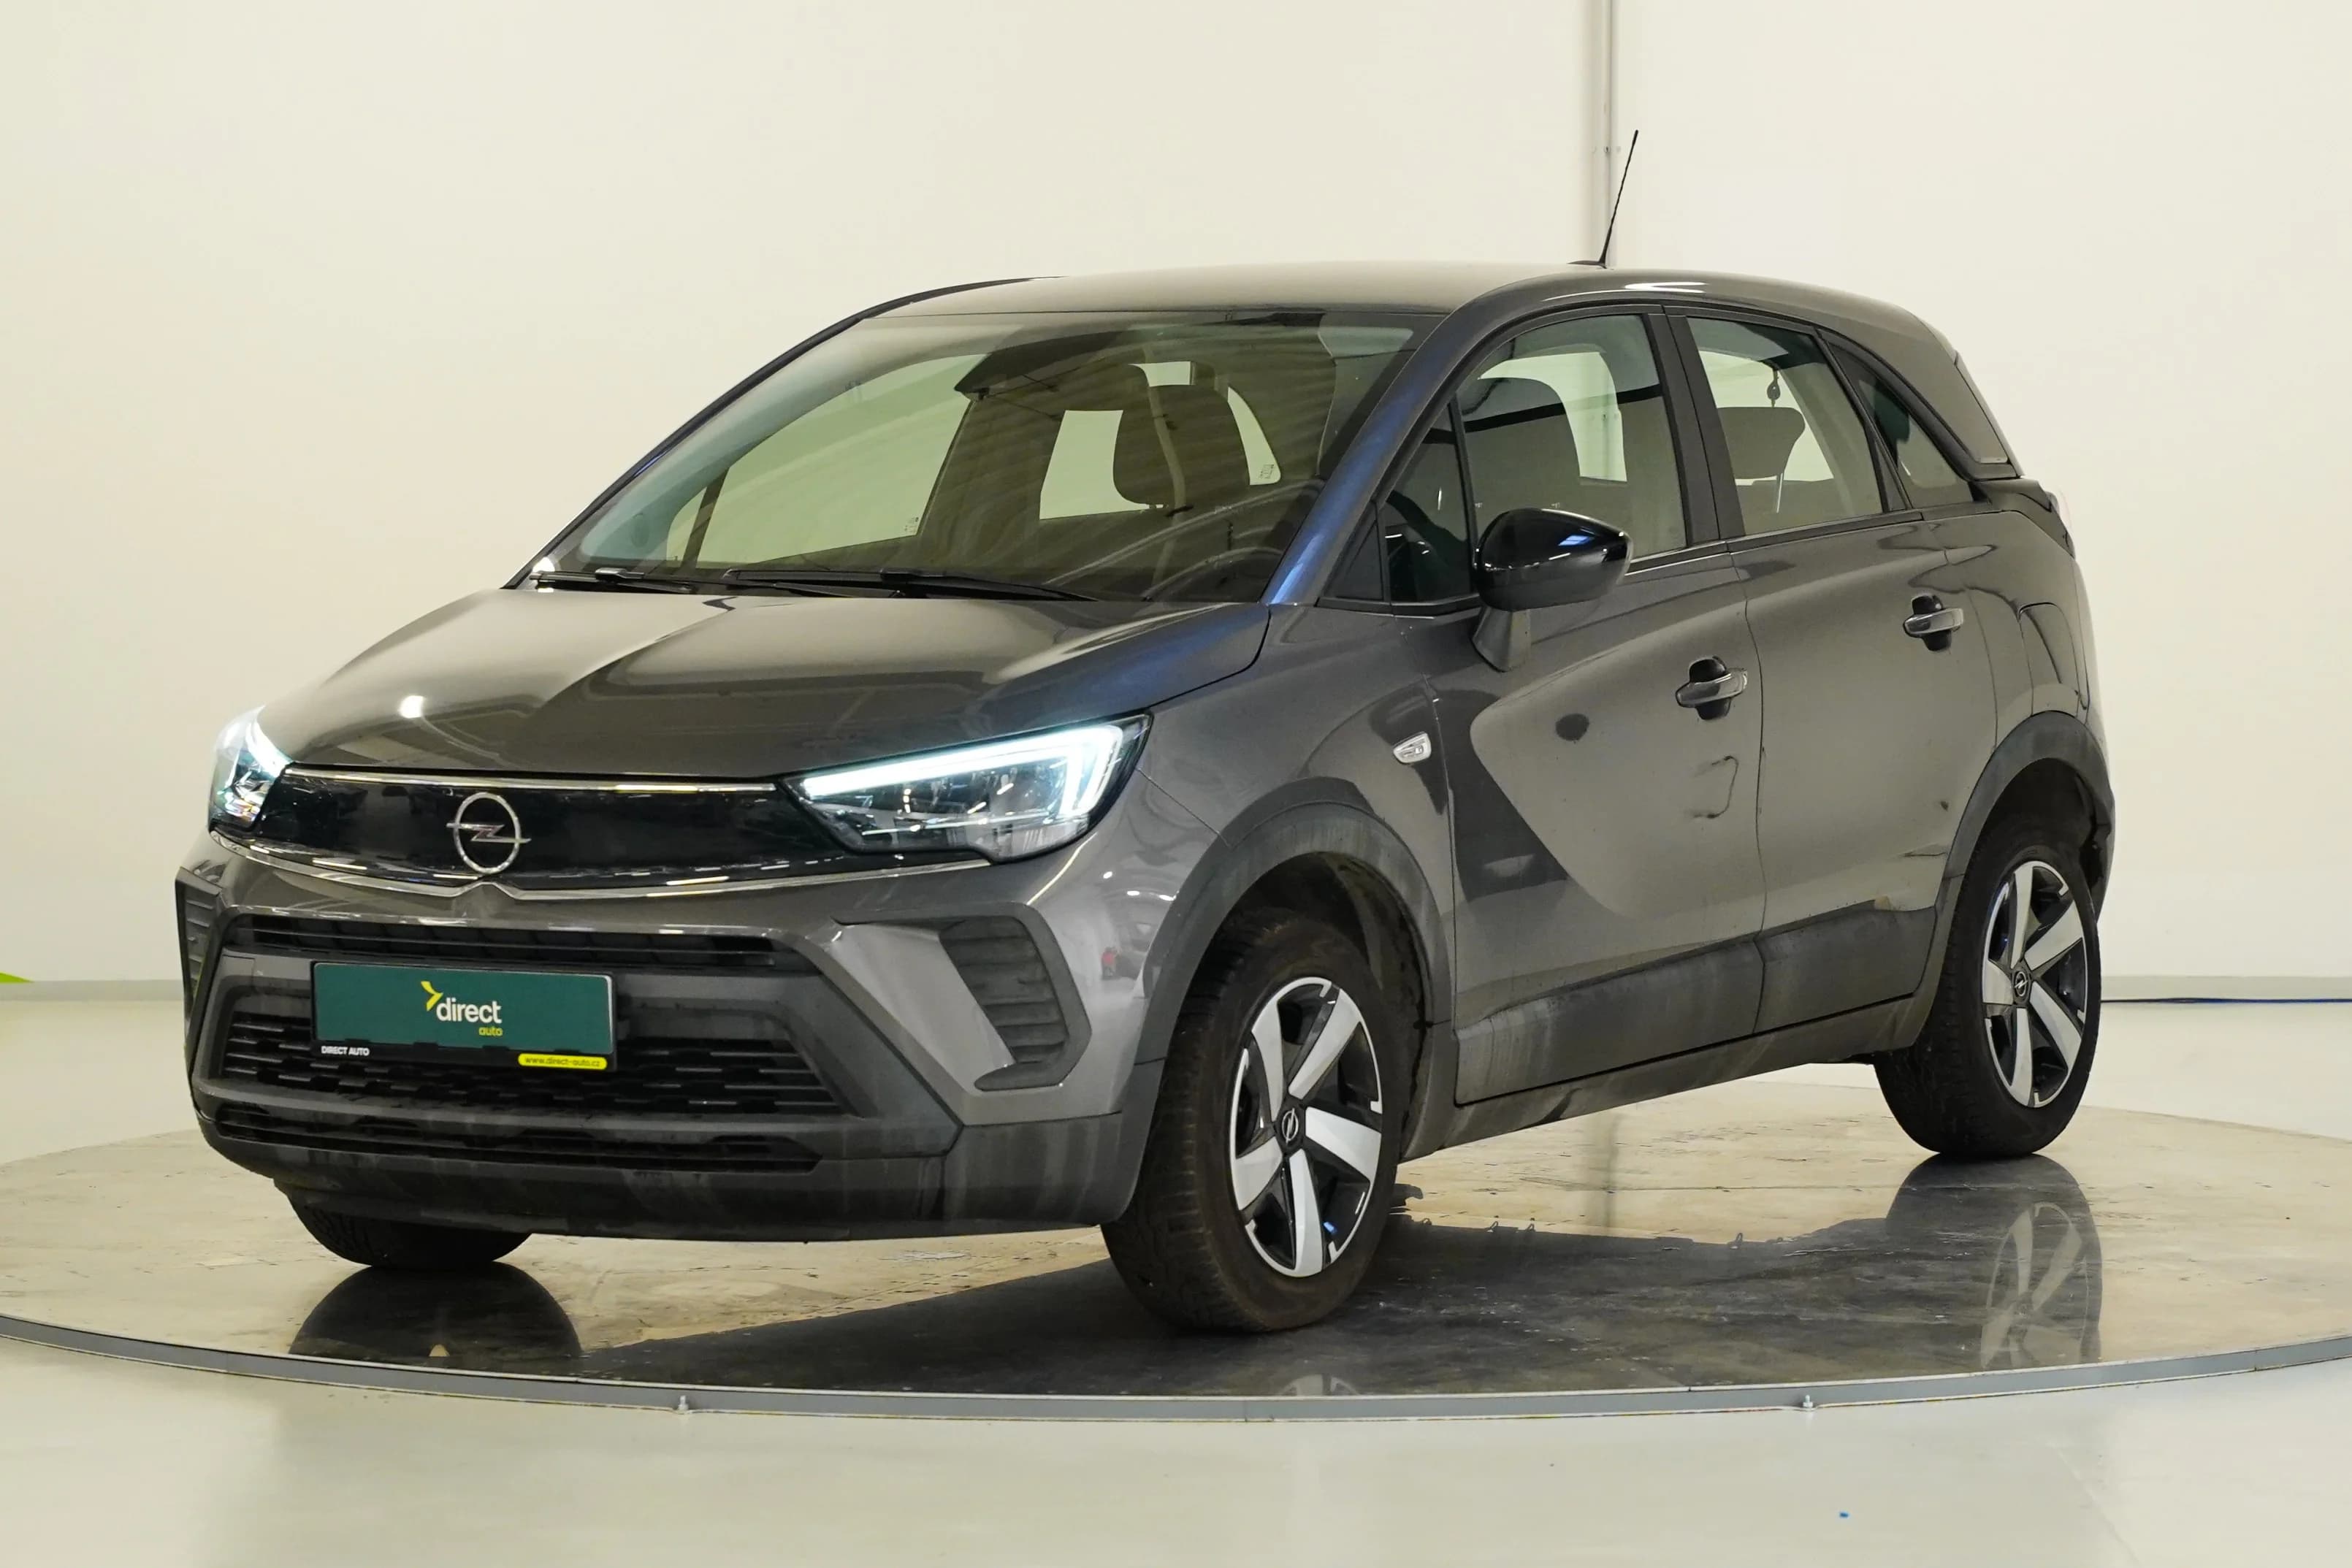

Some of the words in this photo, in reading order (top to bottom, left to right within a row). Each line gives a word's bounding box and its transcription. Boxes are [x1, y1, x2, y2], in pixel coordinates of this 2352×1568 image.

[436, 998, 502, 1023] direct
[478, 1026, 503, 1036] auto
[321, 1046, 348, 1055] DIRECT
[348, 1047, 370, 1056] AUTO
[525, 1057, 600, 1066] www.direct-auto.cz
